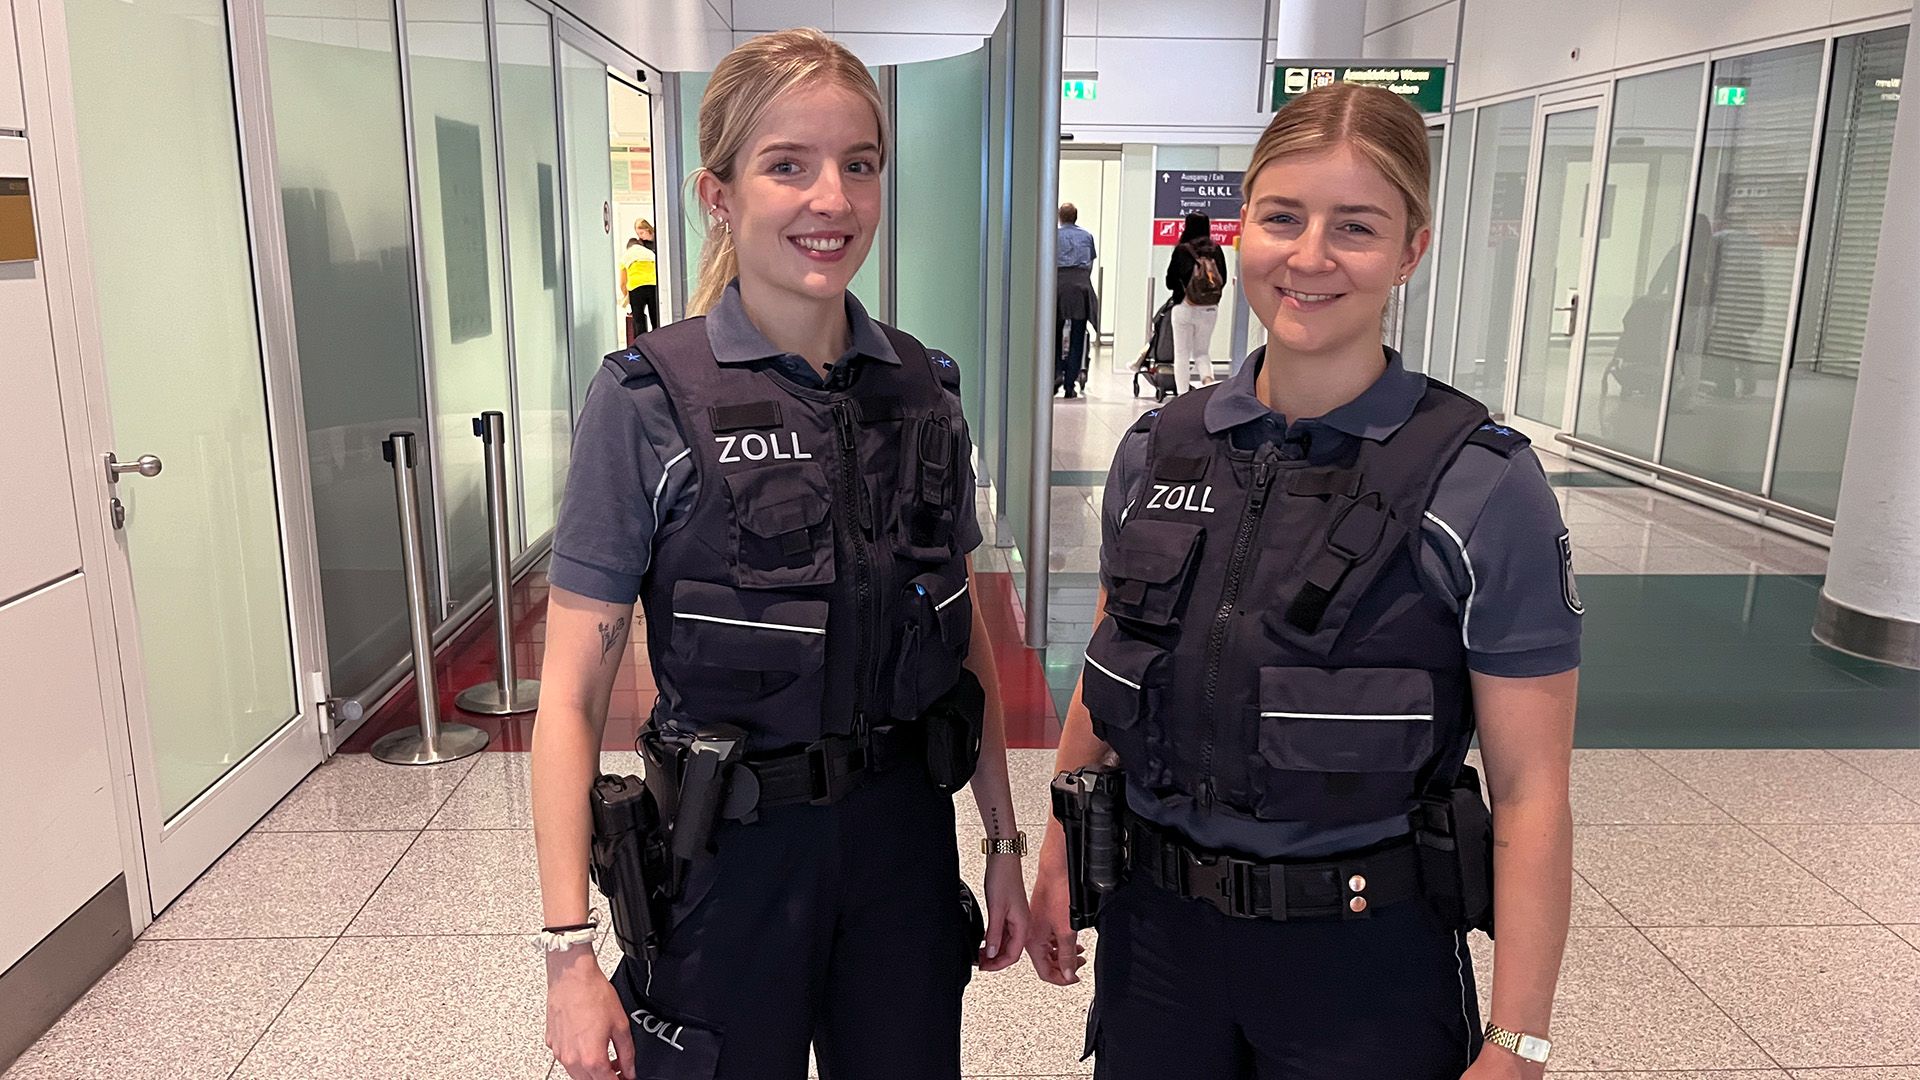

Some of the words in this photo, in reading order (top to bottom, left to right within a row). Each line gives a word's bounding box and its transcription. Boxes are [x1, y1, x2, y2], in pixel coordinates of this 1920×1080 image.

[1181, 173, 1208, 182] Ausgang
[1210, 223, 1237, 232] mkehr
[714, 431, 812, 464] ZOLL
[1146, 484, 1215, 513] ZOLL
[630, 1009, 684, 1051] ZOLL
